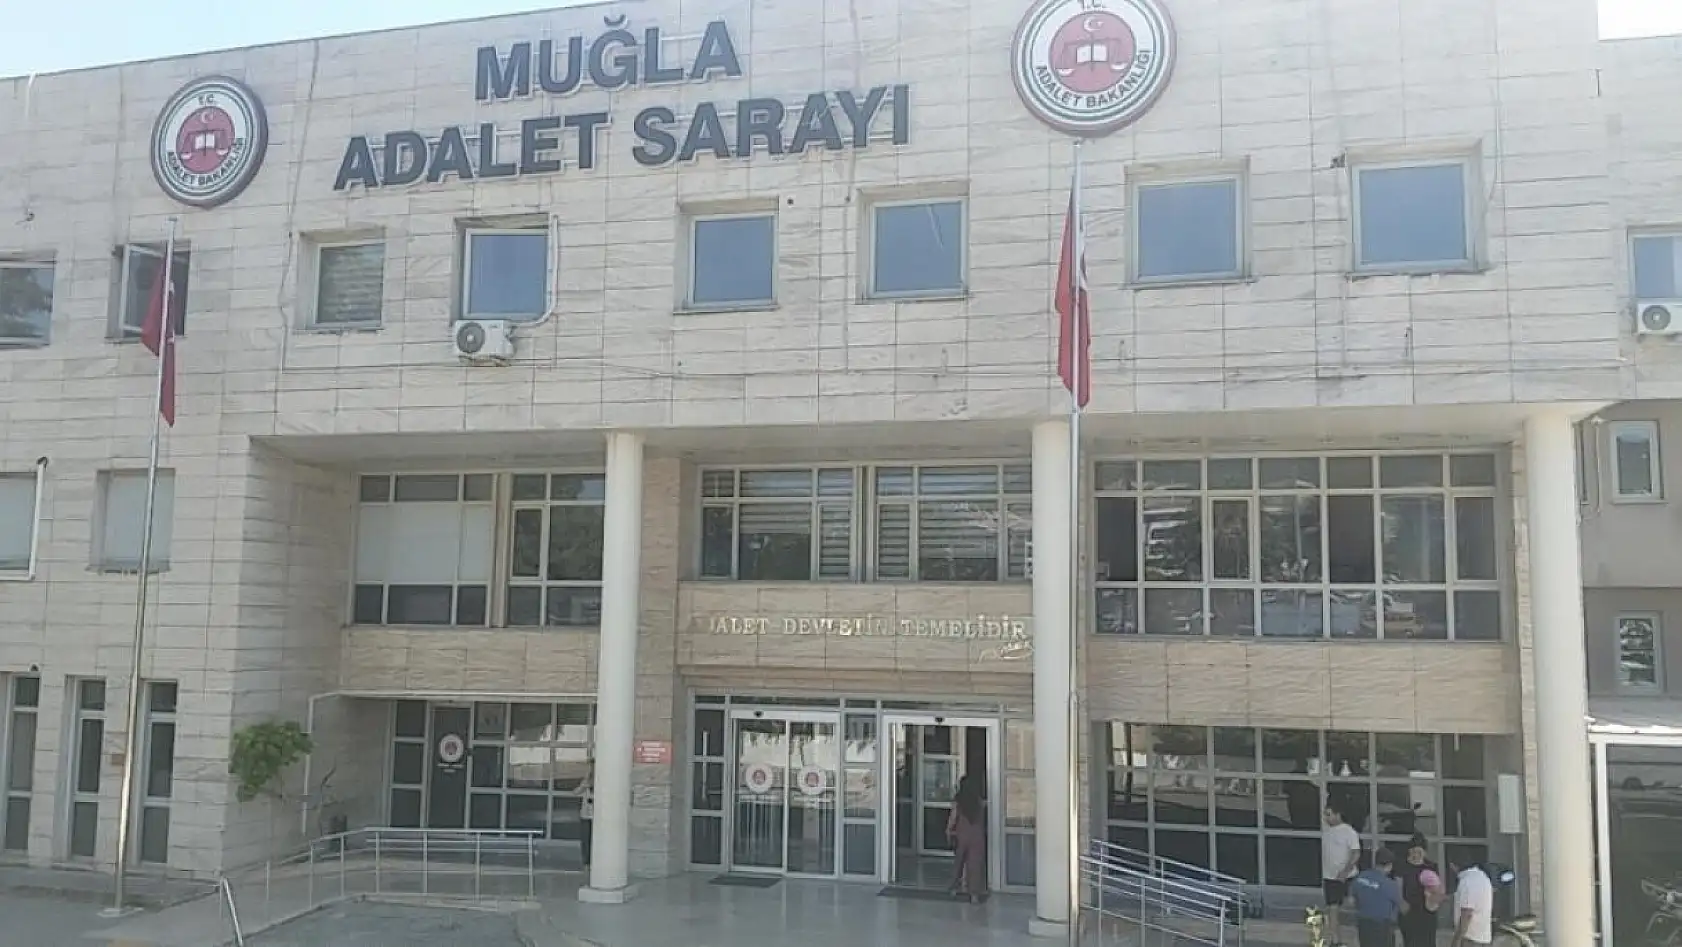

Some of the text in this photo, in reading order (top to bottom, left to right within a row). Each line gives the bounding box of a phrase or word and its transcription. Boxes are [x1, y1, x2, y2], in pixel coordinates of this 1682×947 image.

[475, 14, 742, 101] MUĞLA
[1035, 65, 1084, 107] ADALET
[333, 84, 910, 191] ADALET SARAYI
[693, 615, 769, 636] ALET
[901, 614, 1028, 640] TEMELİDİR
